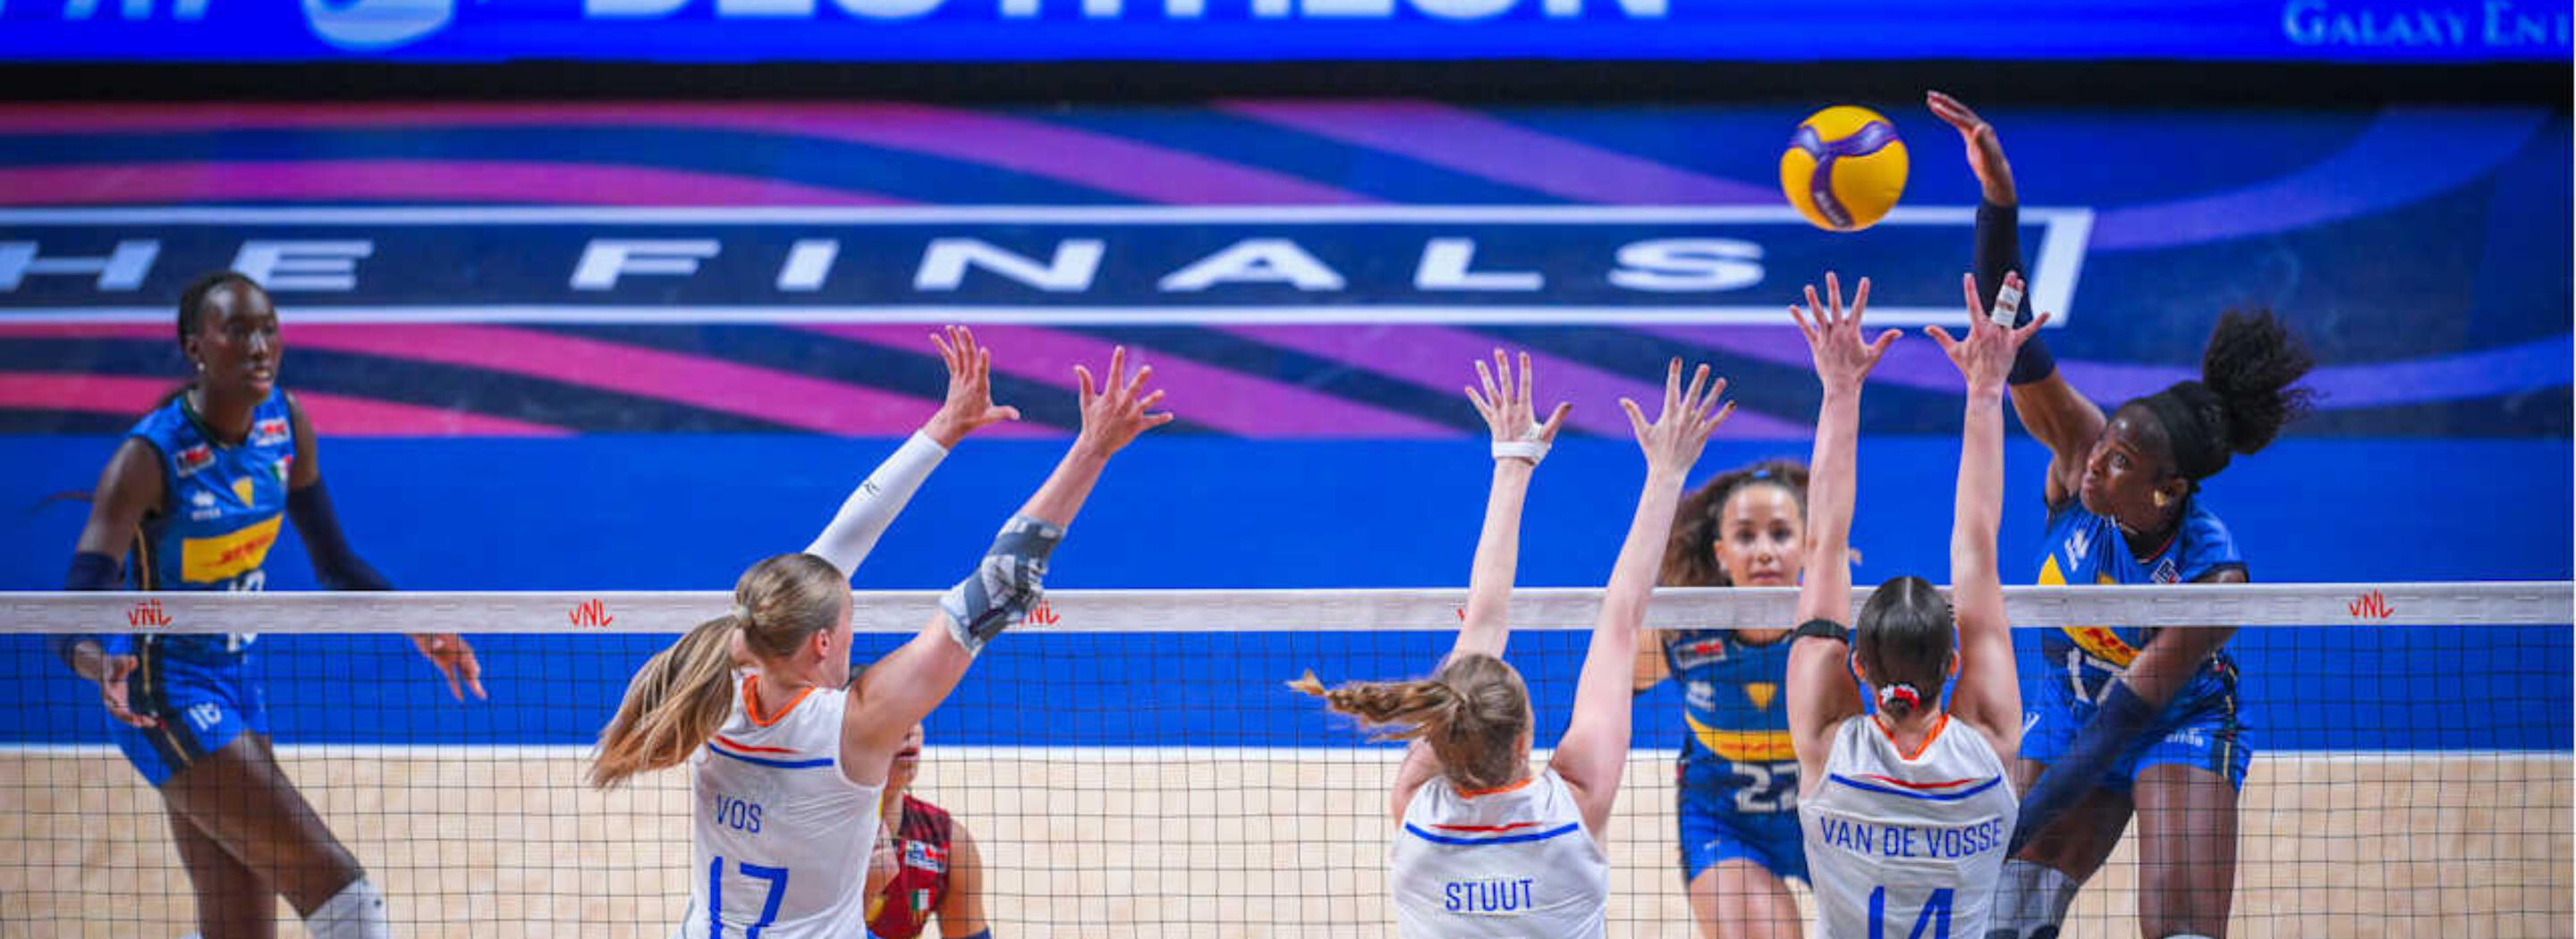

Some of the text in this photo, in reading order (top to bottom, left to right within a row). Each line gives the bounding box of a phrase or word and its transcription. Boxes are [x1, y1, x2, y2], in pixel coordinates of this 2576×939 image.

[570, 239, 1765, 291] FINALS
[128, 598, 172, 627] VNL
[569, 598, 613, 627] VNL
[1019, 599, 1060, 624] NL
[2350, 588, 2394, 618] VNL
[717, 792, 761, 833] VOS
[1820, 815, 2003, 858] VAN DE VOSSE
[709, 856, 789, 939] 17
[1445, 879, 1534, 911] STUUT
